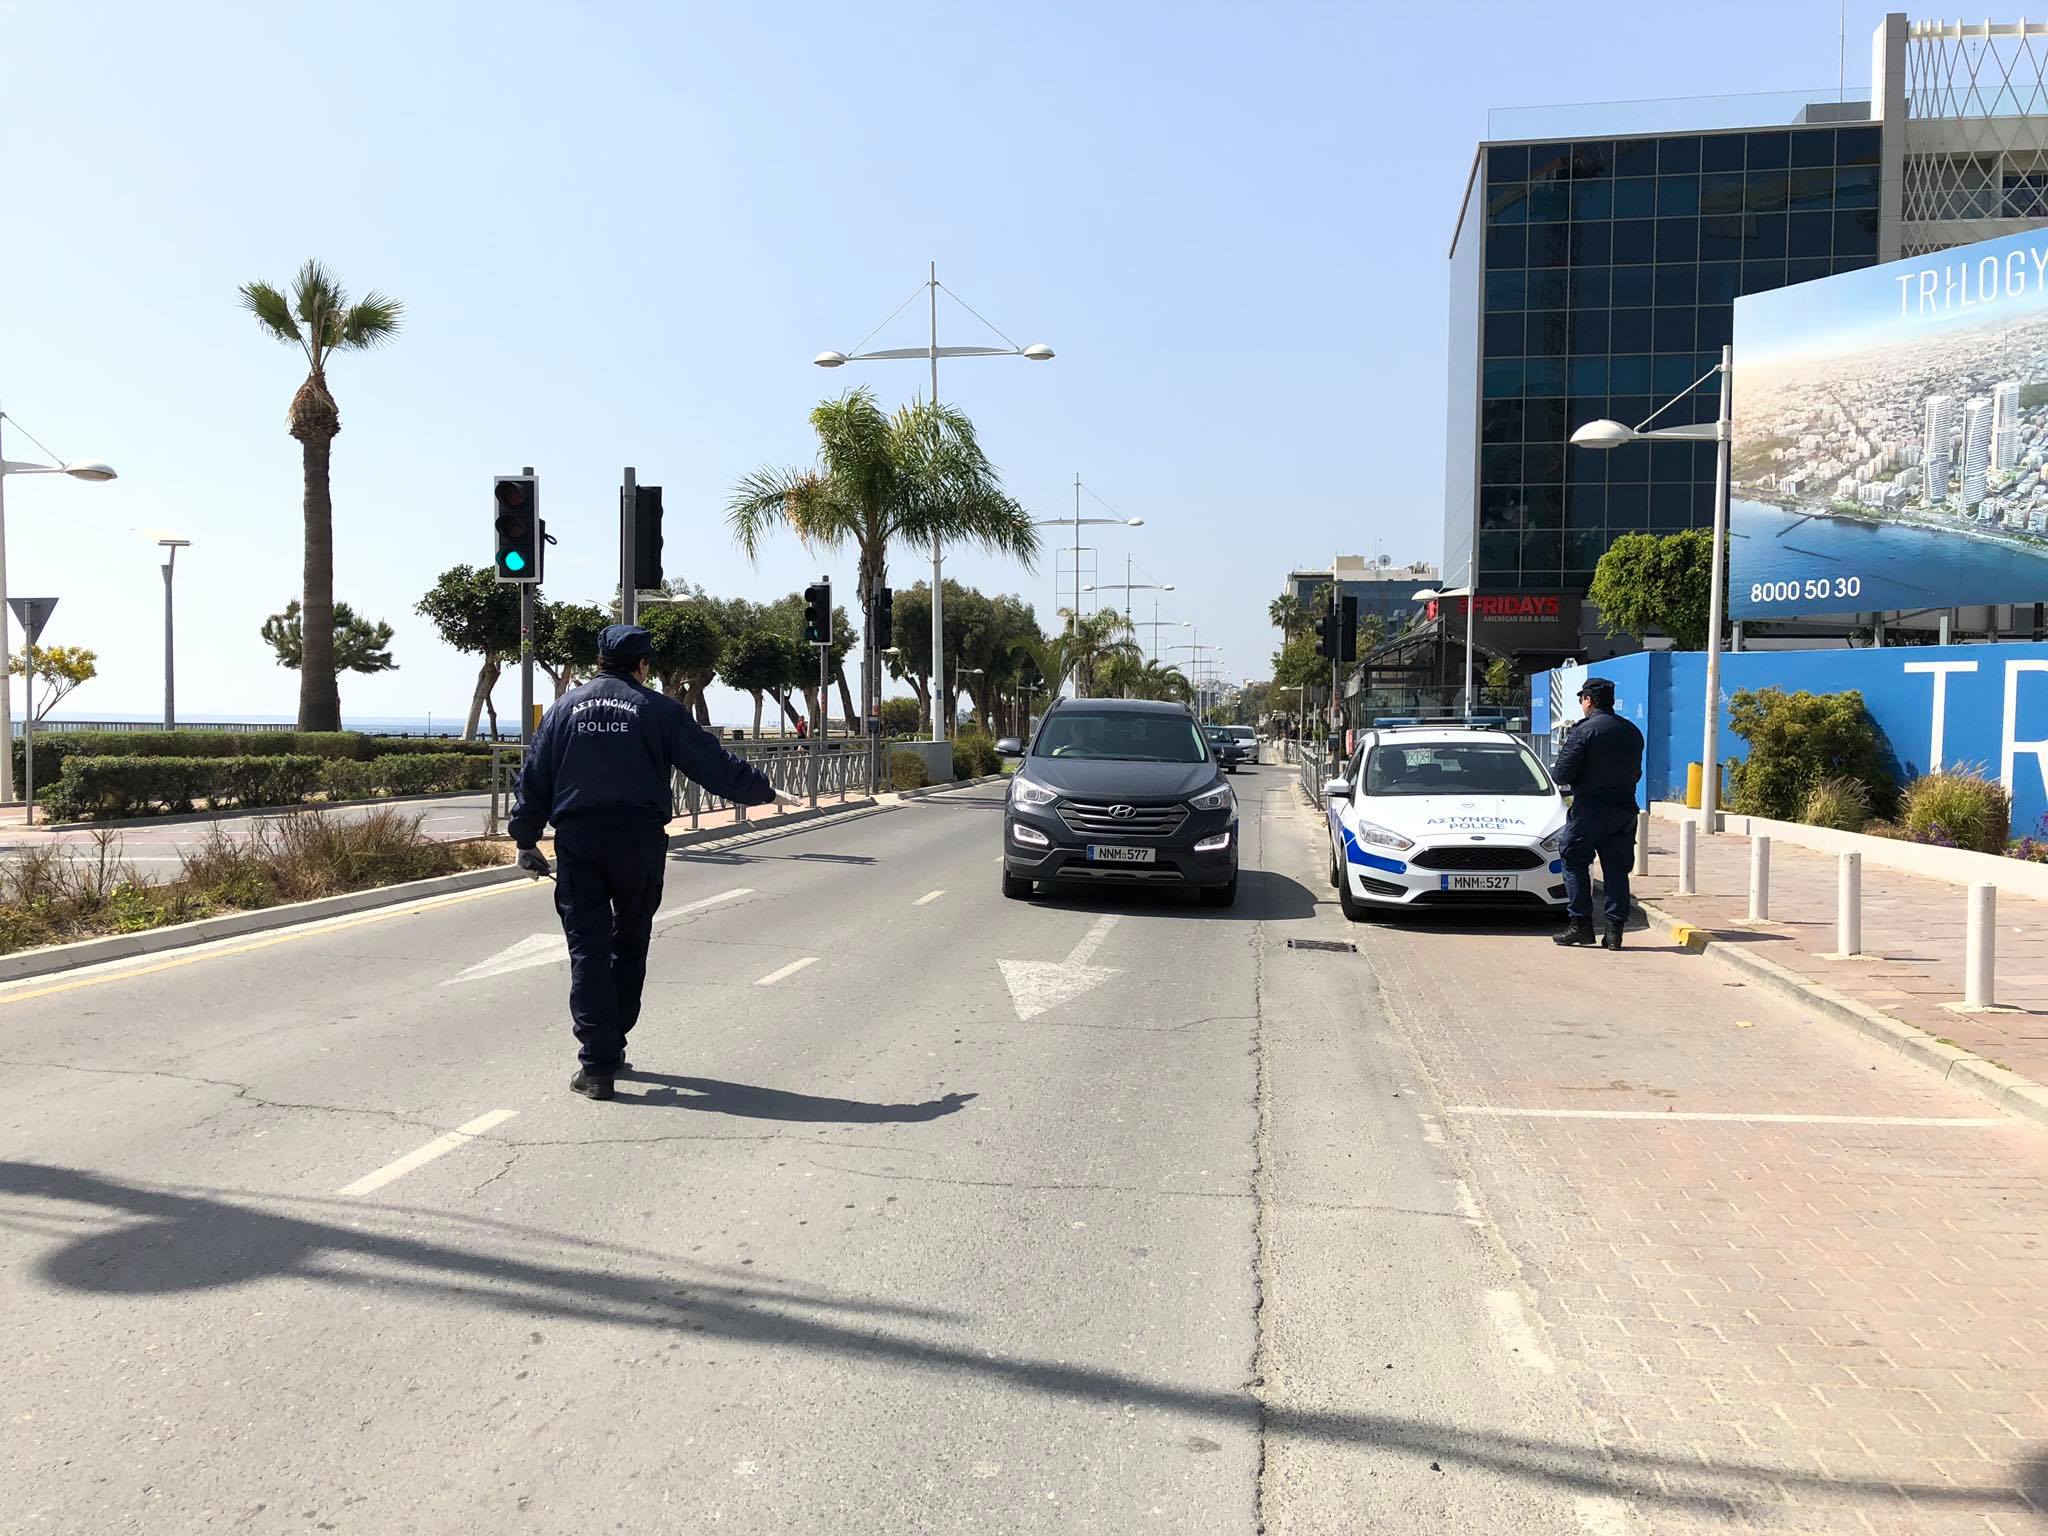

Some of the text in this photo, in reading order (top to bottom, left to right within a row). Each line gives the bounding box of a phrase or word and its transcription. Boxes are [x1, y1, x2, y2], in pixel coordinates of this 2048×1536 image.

[1895, 247, 2048, 318] TRILOGY
[1750, 576, 1861, 603] 8000 50 30
[577, 721, 629, 732] POLICE
